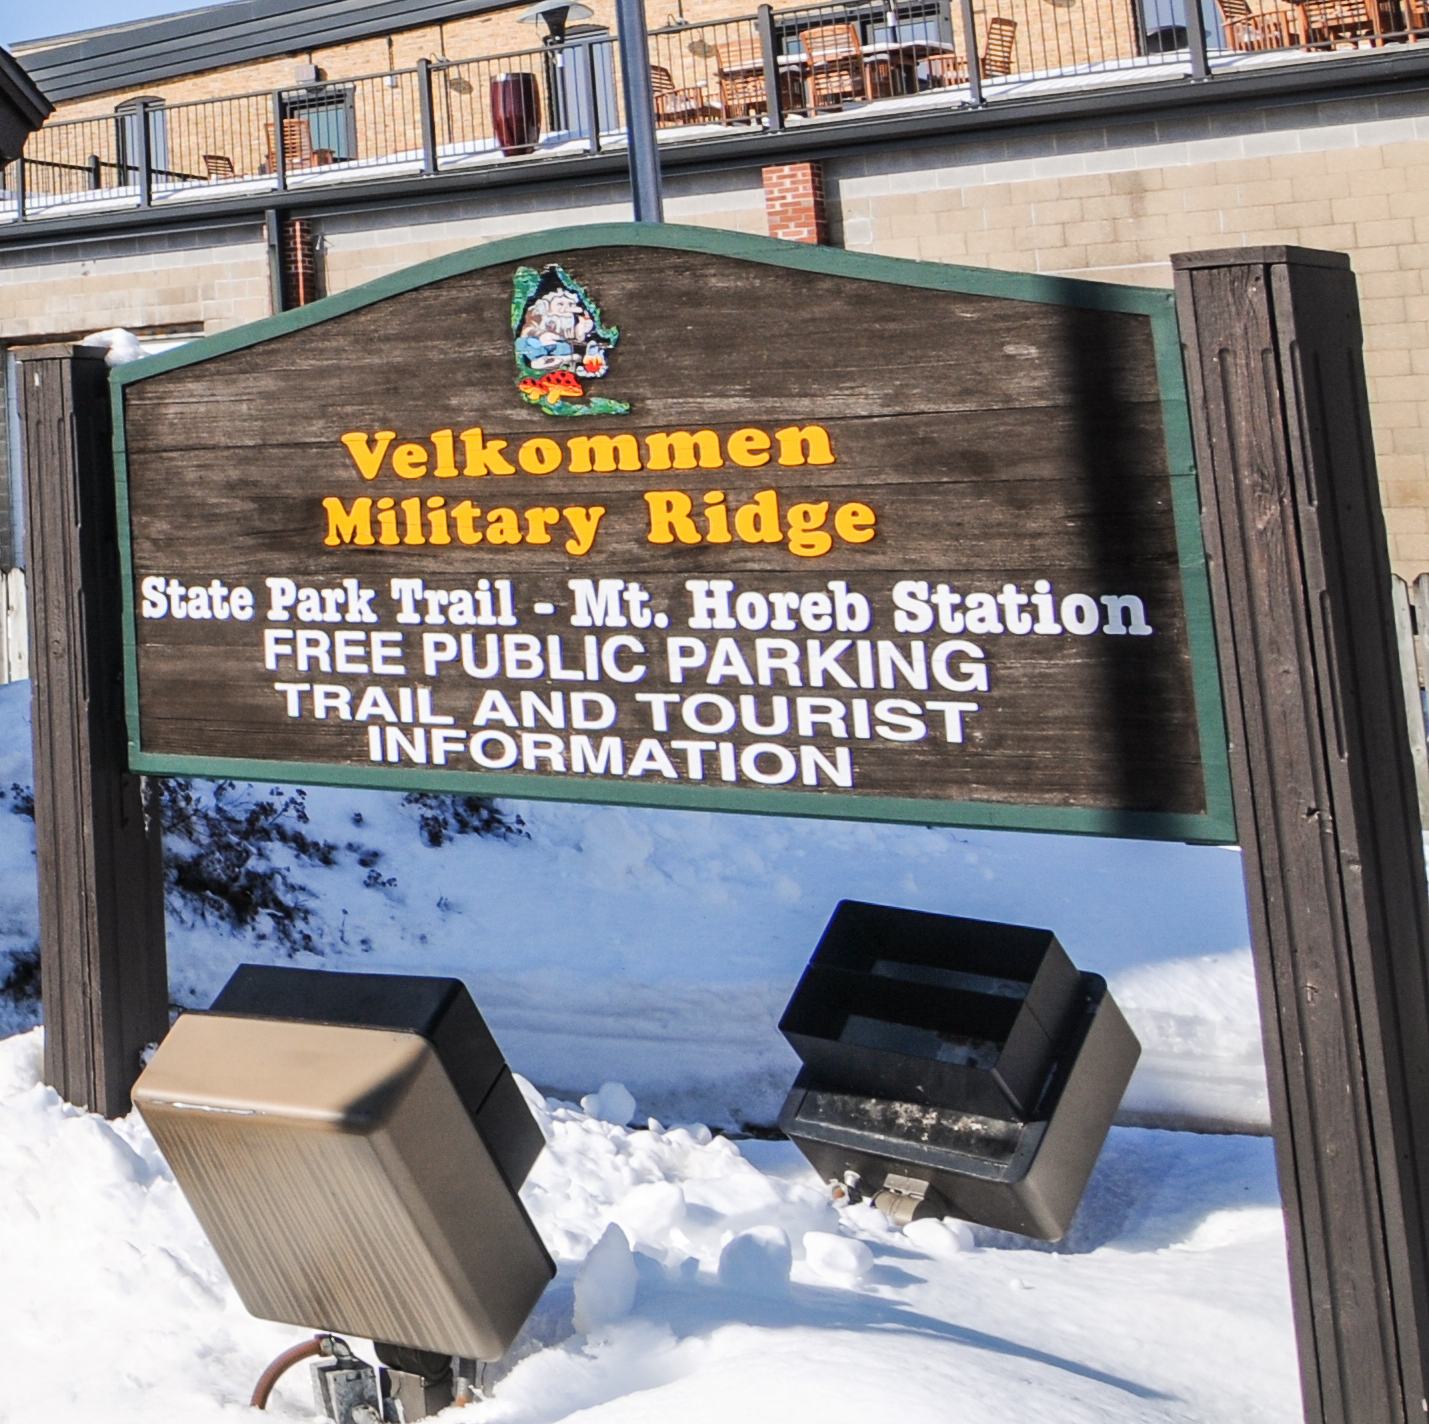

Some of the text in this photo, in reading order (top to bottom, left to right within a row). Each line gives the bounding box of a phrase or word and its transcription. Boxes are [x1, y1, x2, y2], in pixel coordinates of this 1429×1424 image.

[340, 423, 838, 482] Velkommen
[320, 487, 877, 560] Military Ridge
[140, 574, 255, 622] State
[264, 577, 379, 624] Park
[389, 577, 518, 627] Trail
[566, 578, 670, 630] Mt.
[684, 579, 871, 633] Horeb
[891, 579, 1154, 637] Station
[263, 627, 989, 693] FREE PUBLIC PARKING
[273, 681, 980, 745] TRAIL AND TOURIST
[366, 724, 853, 788] INFORMATION
